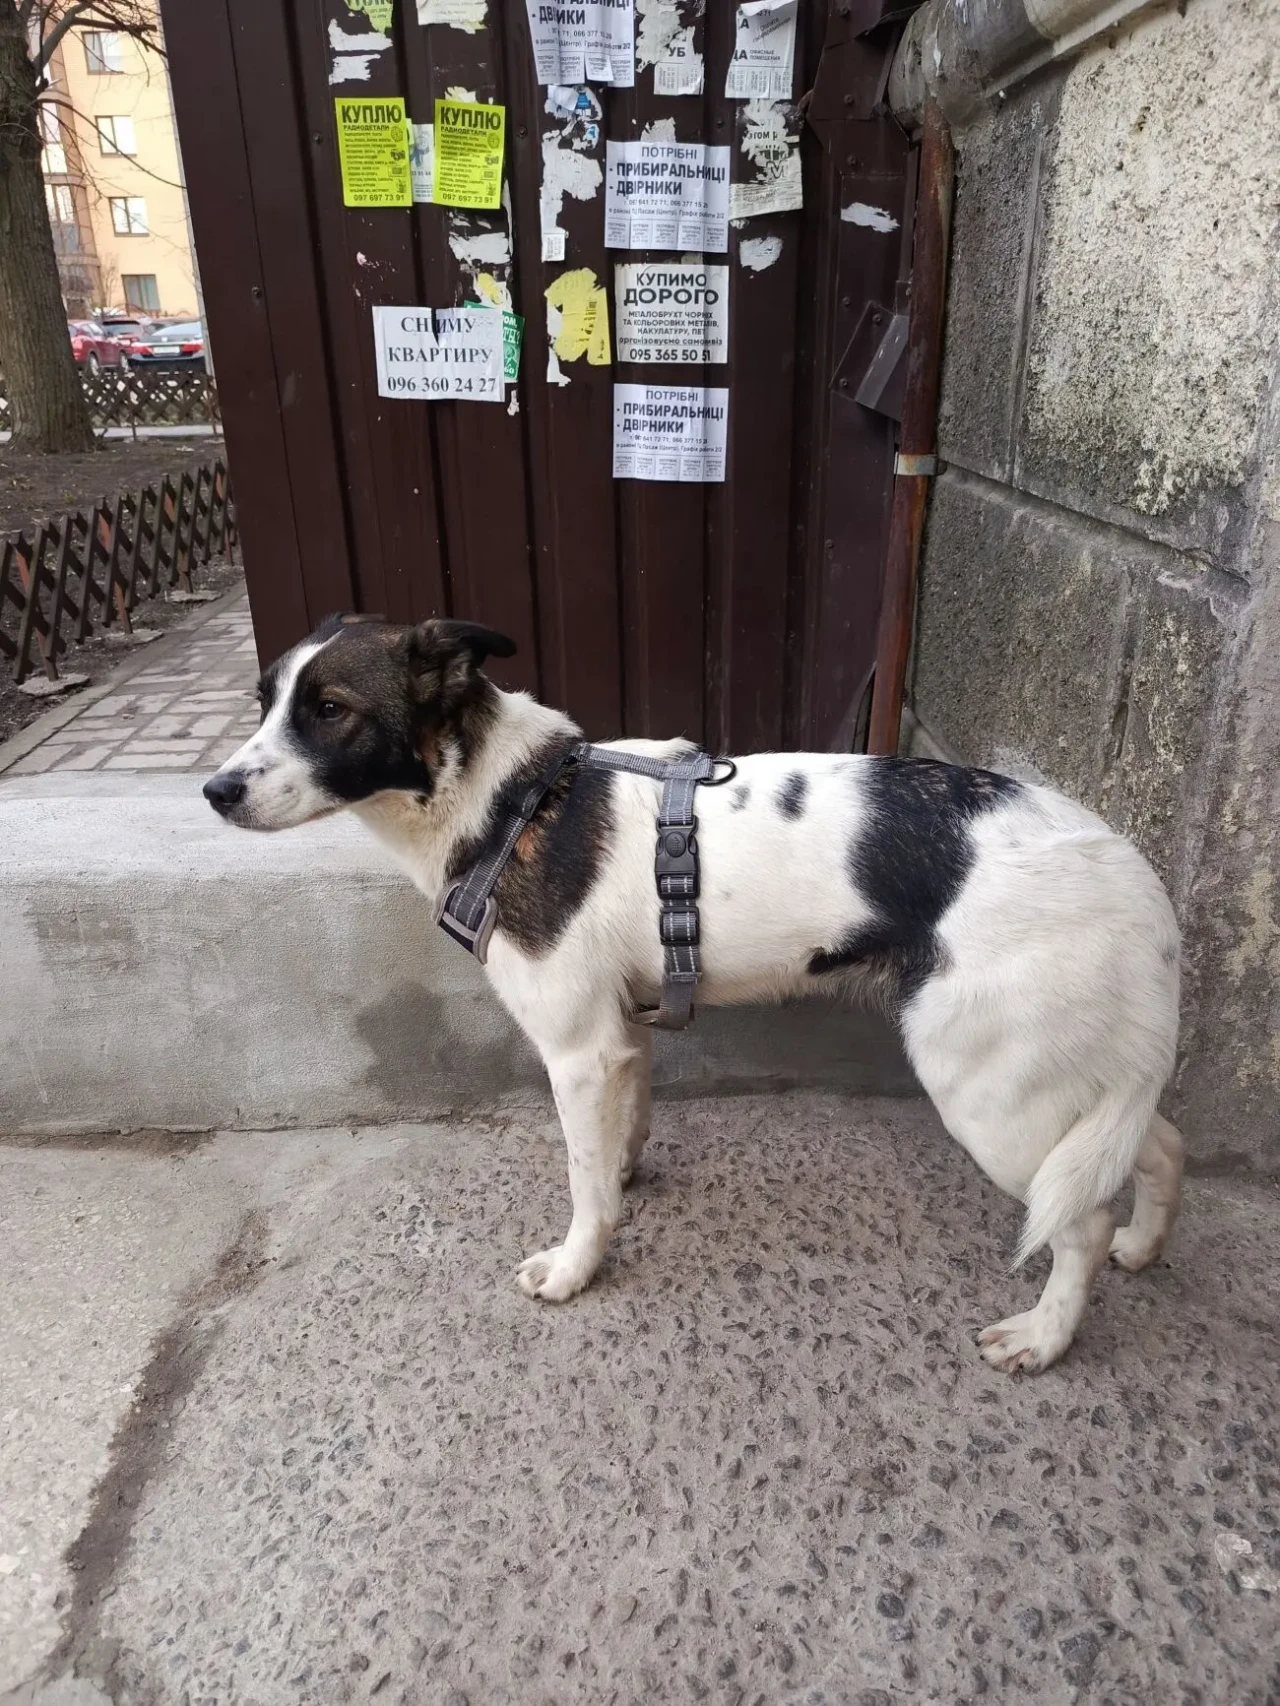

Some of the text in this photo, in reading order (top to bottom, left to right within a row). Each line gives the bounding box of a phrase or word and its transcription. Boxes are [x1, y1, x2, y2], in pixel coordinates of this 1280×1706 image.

[342, 105, 402, 123] КУПЛЮ
[440, 106, 501, 130] КУПЛЮ
[440, 126, 487, 136] РАДИОДЕТАЛИ
[642, 146, 697, 159] ПОТРІБНІ
[616, 162, 726, 183] ПРИБИРАЛЬНИЦІ
[616, 180, 682, 196] ДВІРНИКИ
[637, 273, 707, 286] КУПИМО
[624, 288, 719, 306] ДОРОГО
[401, 317, 476, 333] СНИМУ
[388, 347, 493, 363] КВАРТИРУ
[630, 348, 710, 361] 095 365 50 51
[387, 377, 496, 392] 096 360 24 27
[646, 390, 698, 402] ПОТРІБНІ
[623, 403, 723, 421] ПРИБИРАЛЬНИЦІ
[623, 419, 684, 433] ДВІРНИКИ
